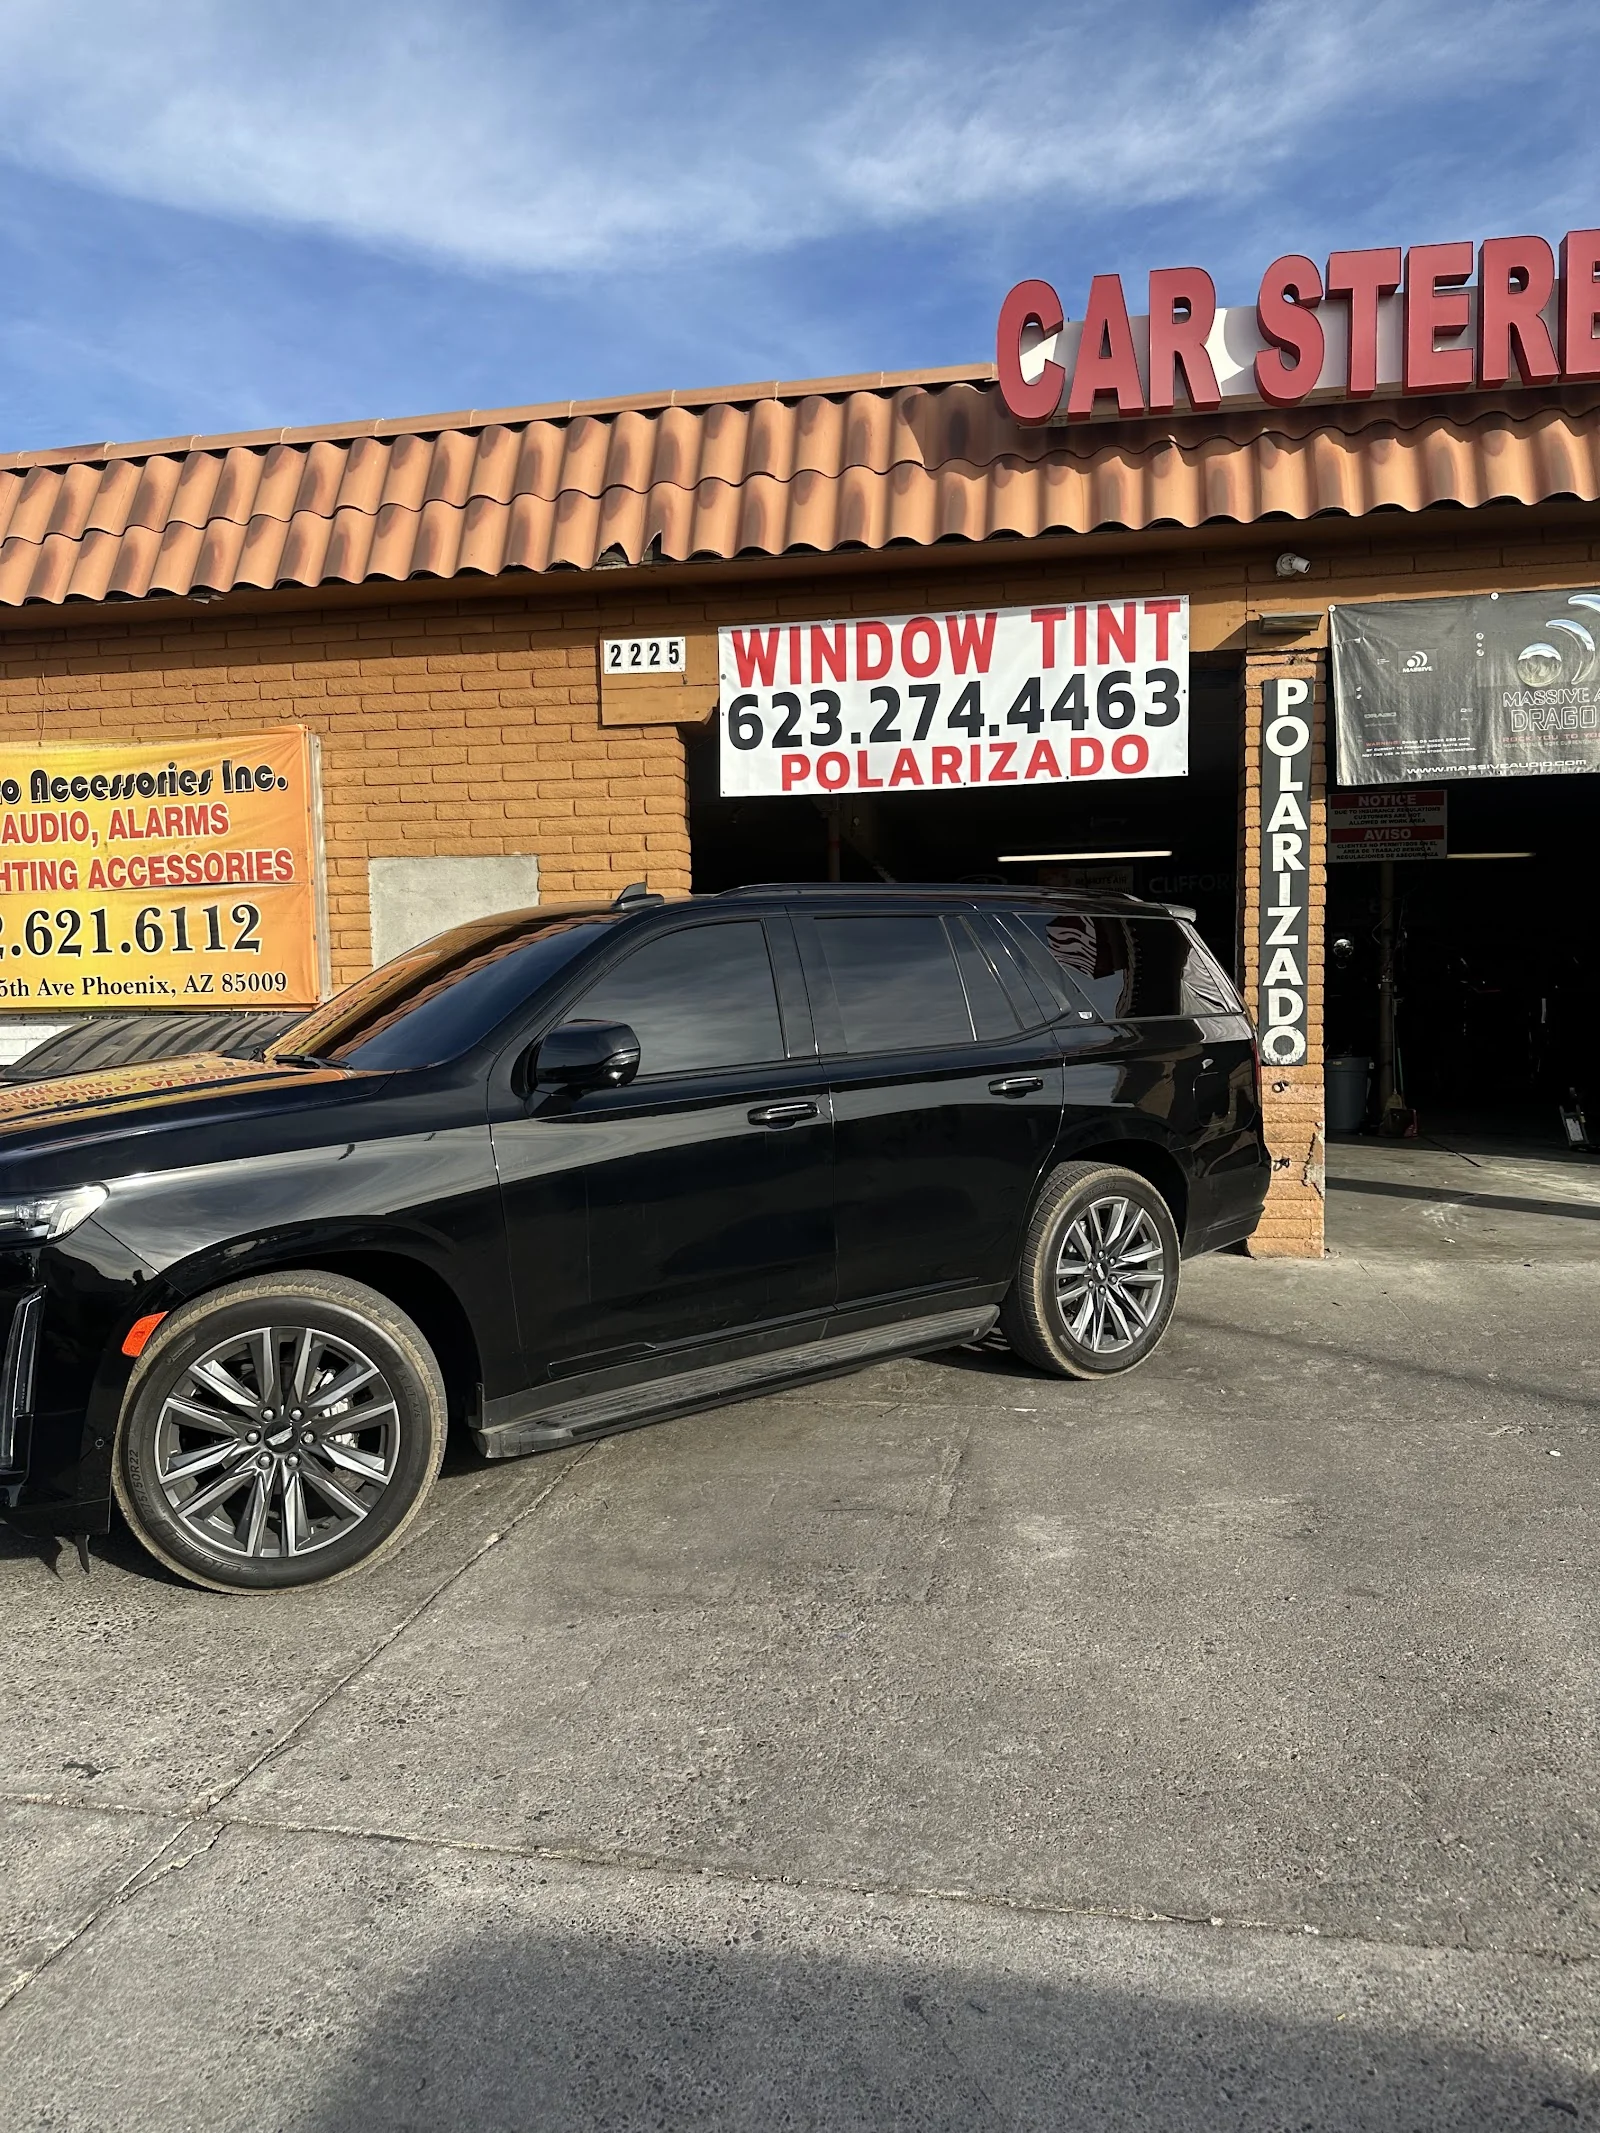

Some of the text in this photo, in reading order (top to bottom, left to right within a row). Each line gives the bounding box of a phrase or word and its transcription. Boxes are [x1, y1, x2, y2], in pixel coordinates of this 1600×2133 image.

[997, 266, 1221, 426] CAR
[610, 641, 681, 668] 2225
[730, 599, 1181, 688] WINDOW TINT
[727, 667, 1181, 751] 623.274.4463
[1502, 687, 1591, 707] MASSIVE
[1511, 704, 1597, 732] DRAGO
[30, 762, 213, 804] Accessories
[222, 759, 288, 792] Inc.
[781, 733, 1150, 792] POLARIZADO
[1358, 794, 1417, 807] NOTICE
[1, 803, 230, 848] AUDIO, ALARMS
[1363, 828, 1412, 840] AVISO
[88, 849, 295, 889] ACCESSORIES
[1148, 872, 1235, 895] CLIFFOR
[1262, 678, 1310, 1064] POLARIZADO
[0, 904, 262, 960] .621.6112
[37, 977, 75, 997] Ave
[81, 975, 177, 998] Phoenix,
[183, 974, 215, 994] AZ
[221, 972, 287, 992] 85009
[128, 1449, 155, 1517] 275/50R22
